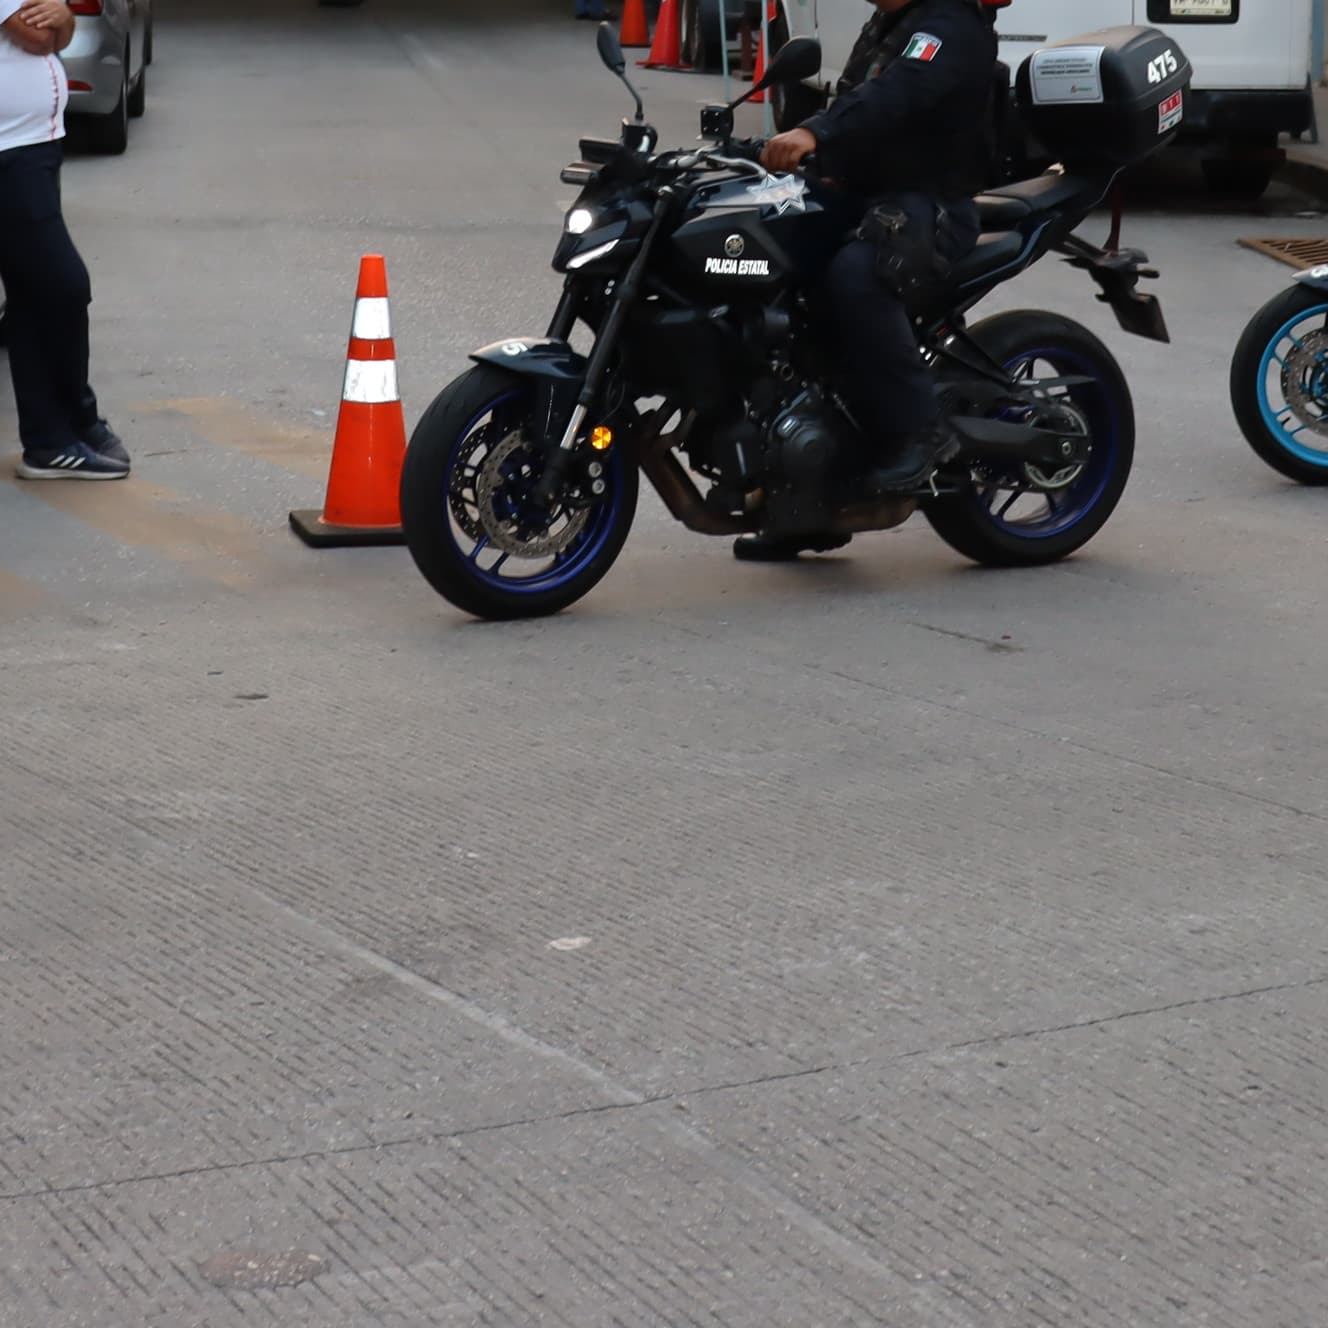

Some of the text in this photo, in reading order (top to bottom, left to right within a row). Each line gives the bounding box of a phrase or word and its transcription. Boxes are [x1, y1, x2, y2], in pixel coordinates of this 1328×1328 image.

[1147, 49, 1178, 84] 475
[705, 257, 769, 275] POLICIA ESTATAL
